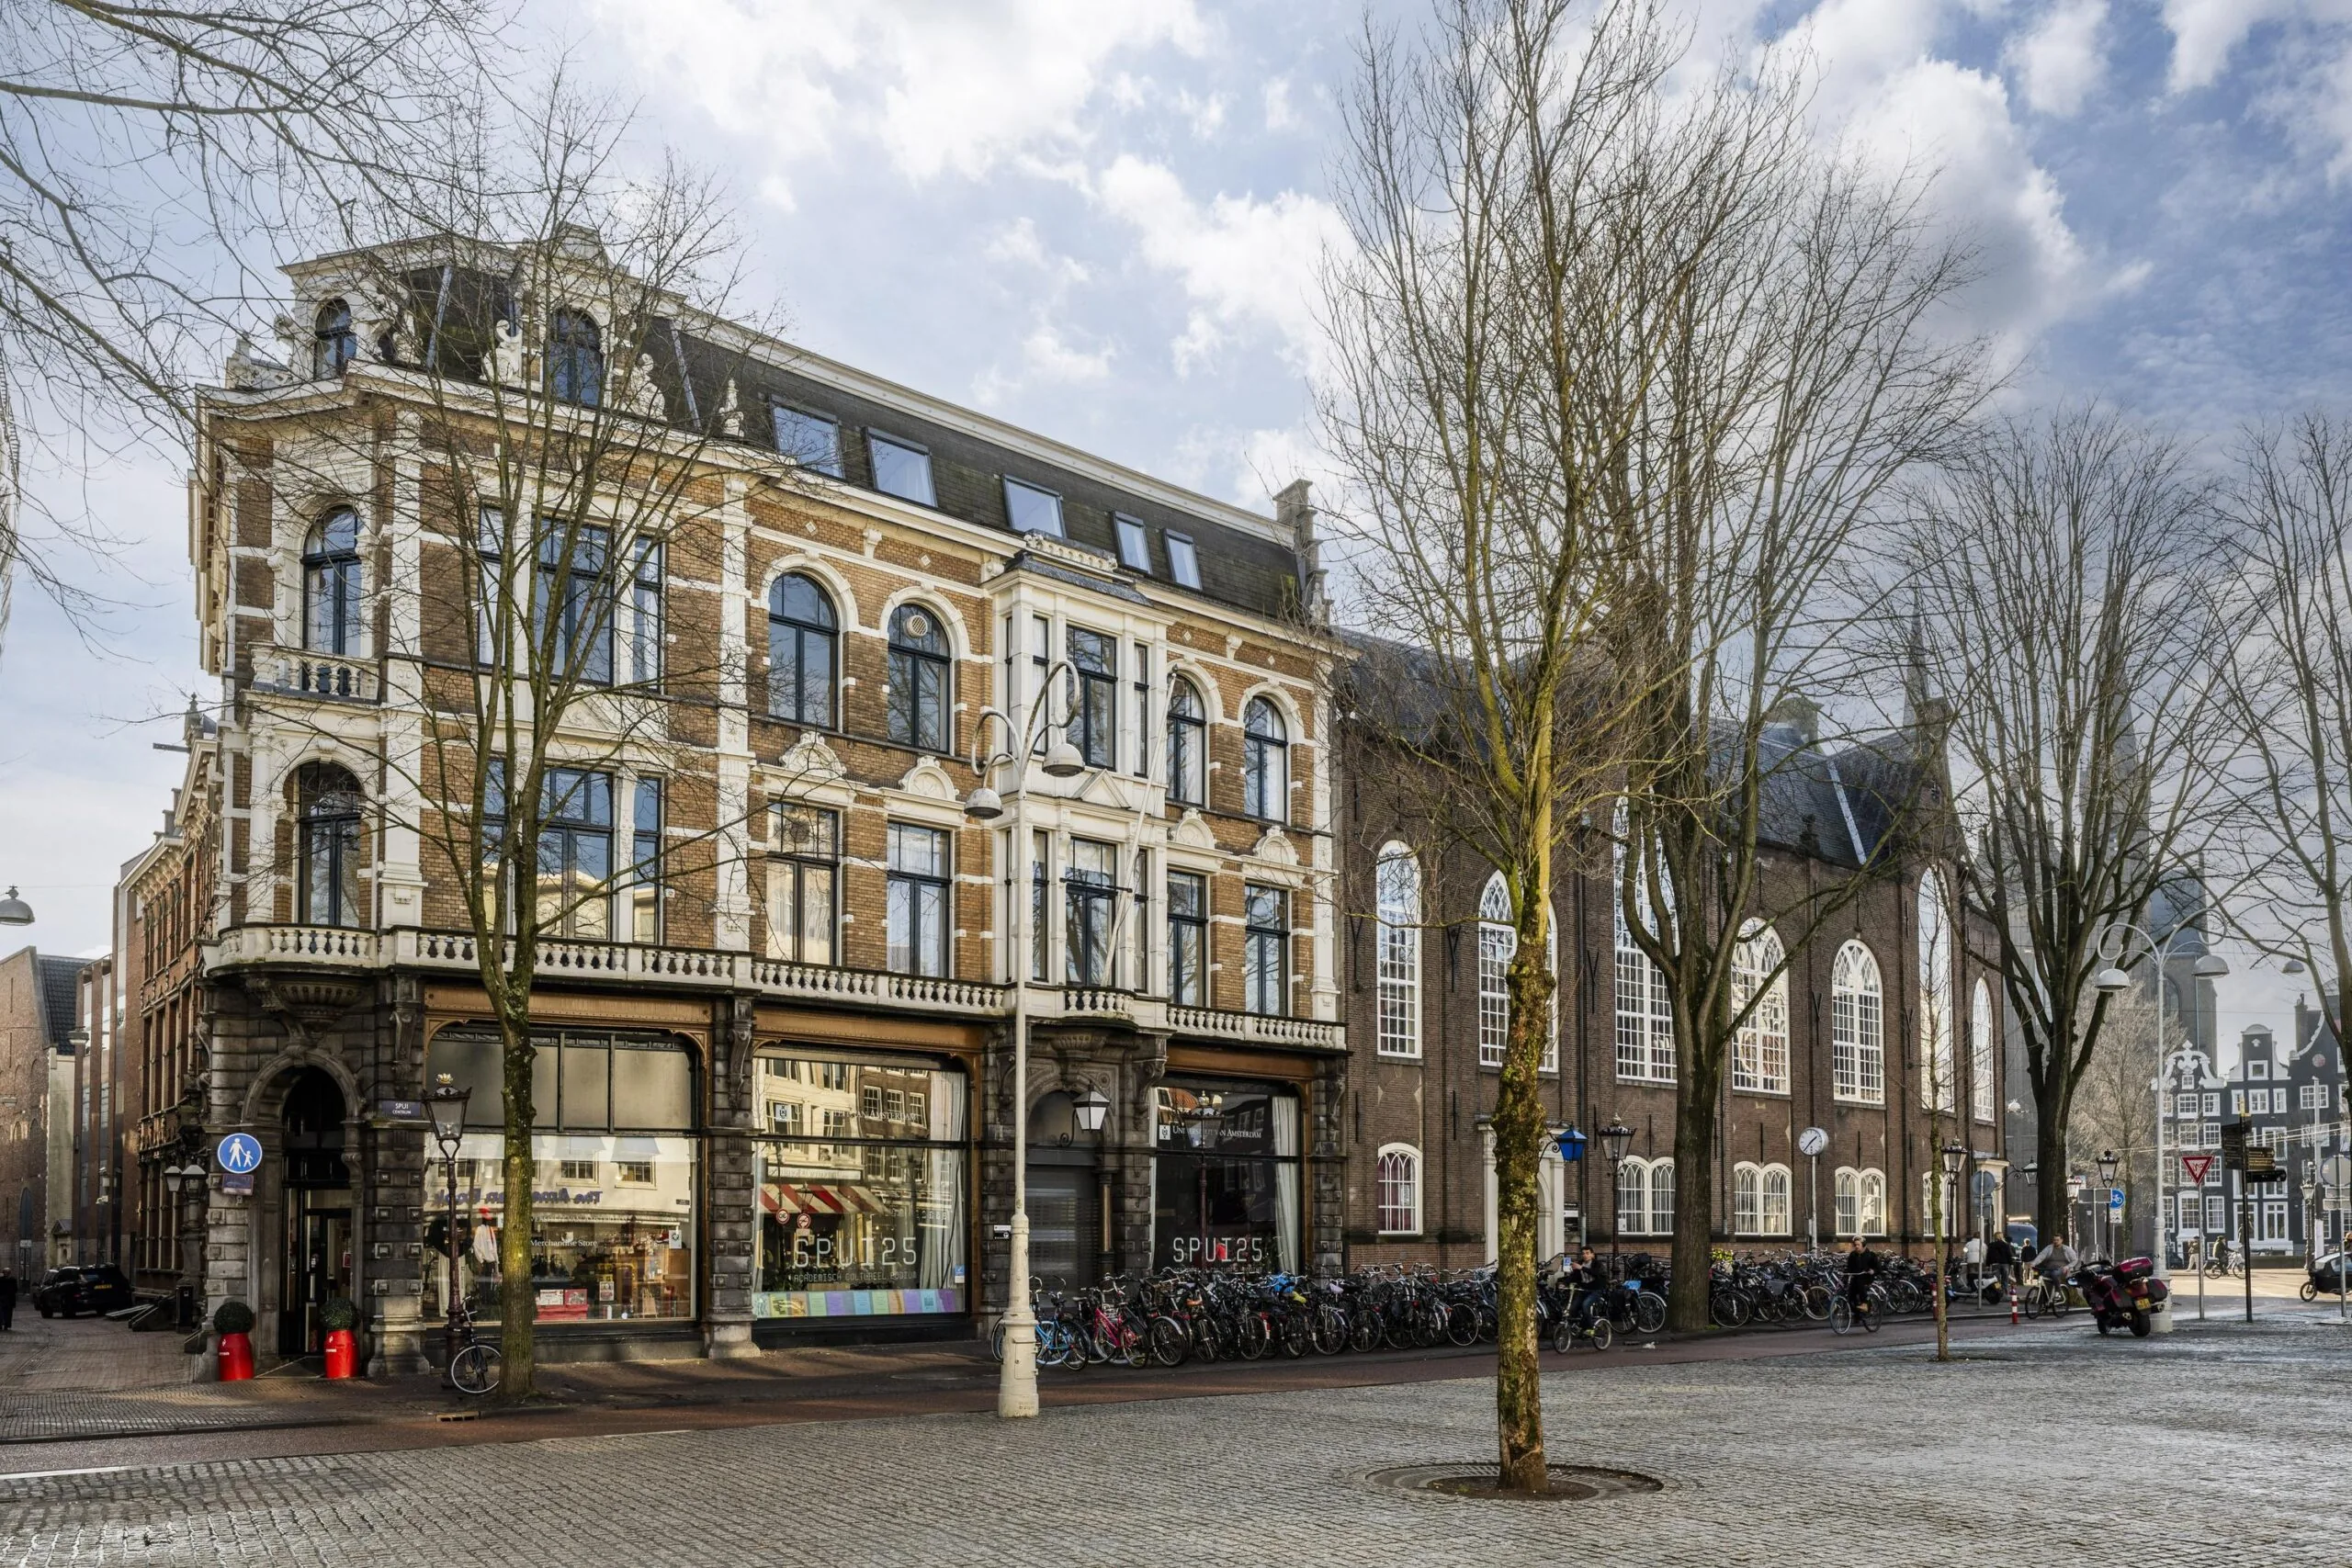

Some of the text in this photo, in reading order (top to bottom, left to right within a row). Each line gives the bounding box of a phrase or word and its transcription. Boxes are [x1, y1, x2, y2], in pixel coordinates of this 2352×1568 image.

[1227, 1129, 1261, 1138] AMSTERDAM
[579, 1239, 598, 1247] Store
[794, 1237, 917, 1269] SPUI25
[1173, 1237, 1262, 1262] SPUI25
[794, 1272, 842, 1282] ACADEMISCH
